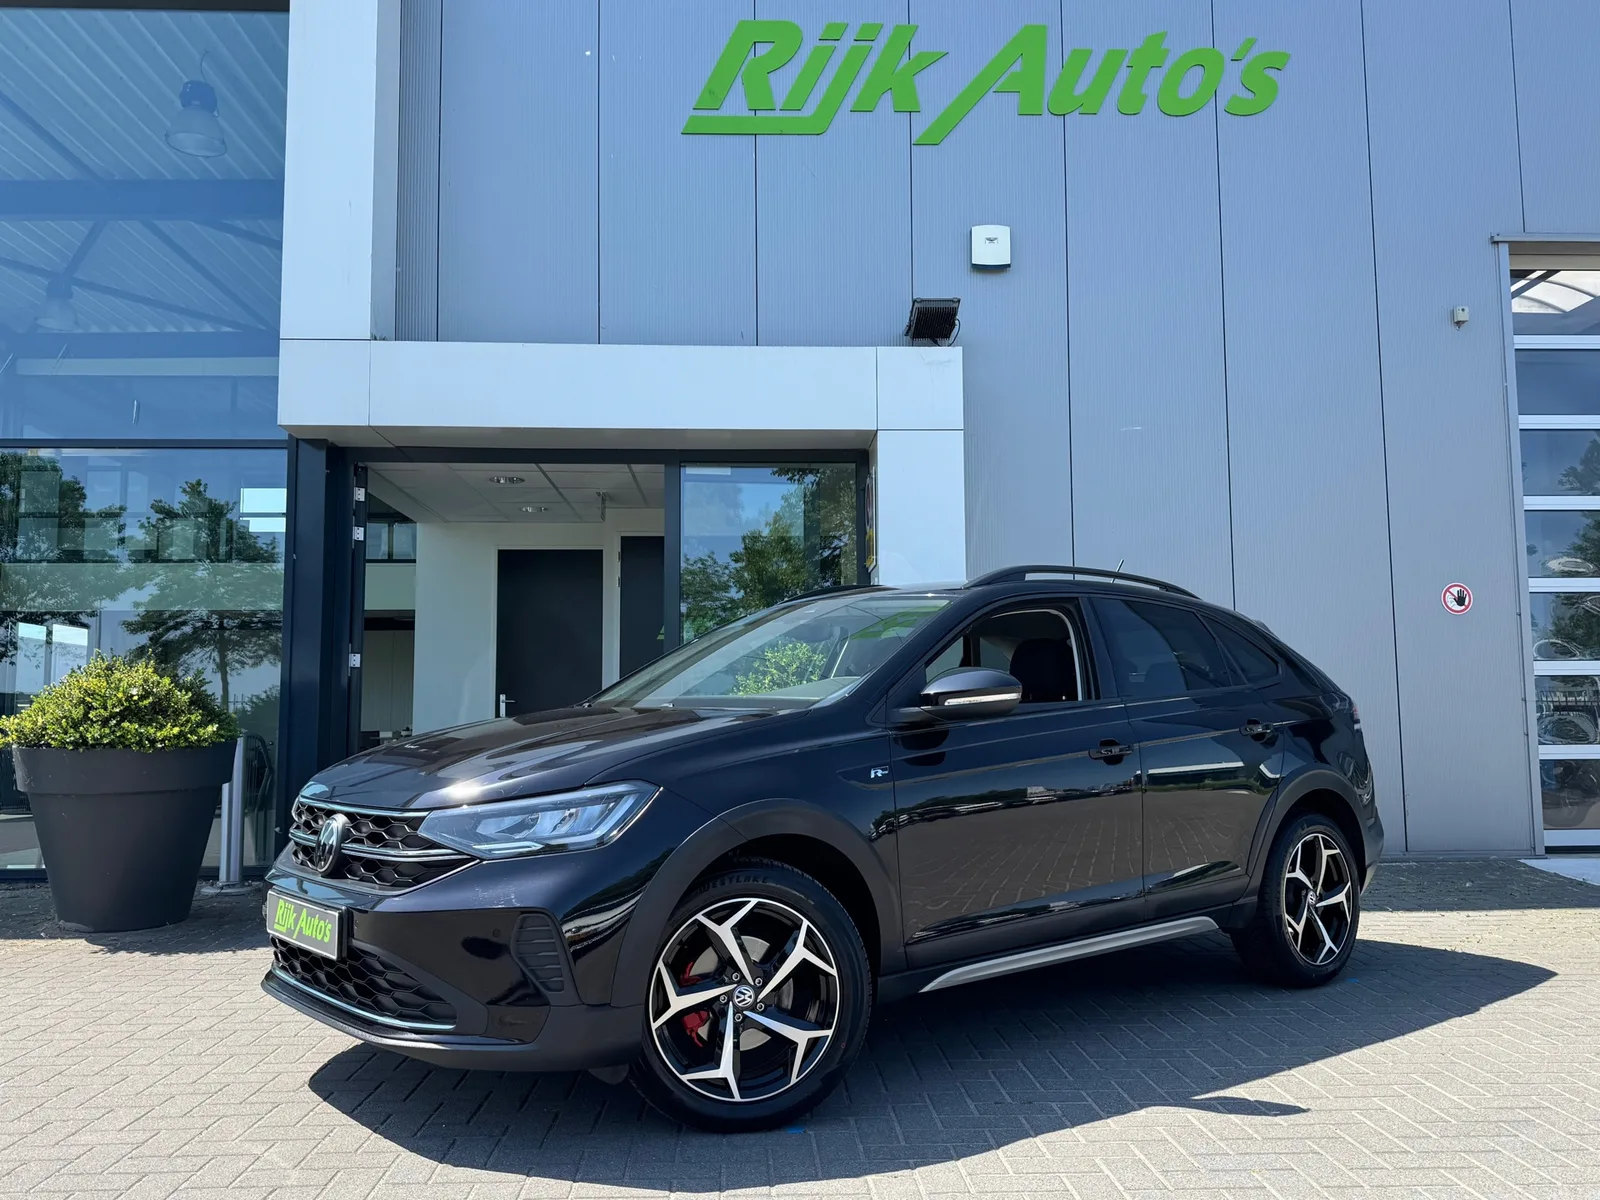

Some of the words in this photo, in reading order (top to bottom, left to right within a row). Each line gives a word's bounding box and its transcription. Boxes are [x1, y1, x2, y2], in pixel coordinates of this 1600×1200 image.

[681, 19, 949, 135] Rijk
[912, 24, 1291, 146] Auto's
[273, 899, 297, 933] Rijk
[293, 908, 332, 943] Auto's
